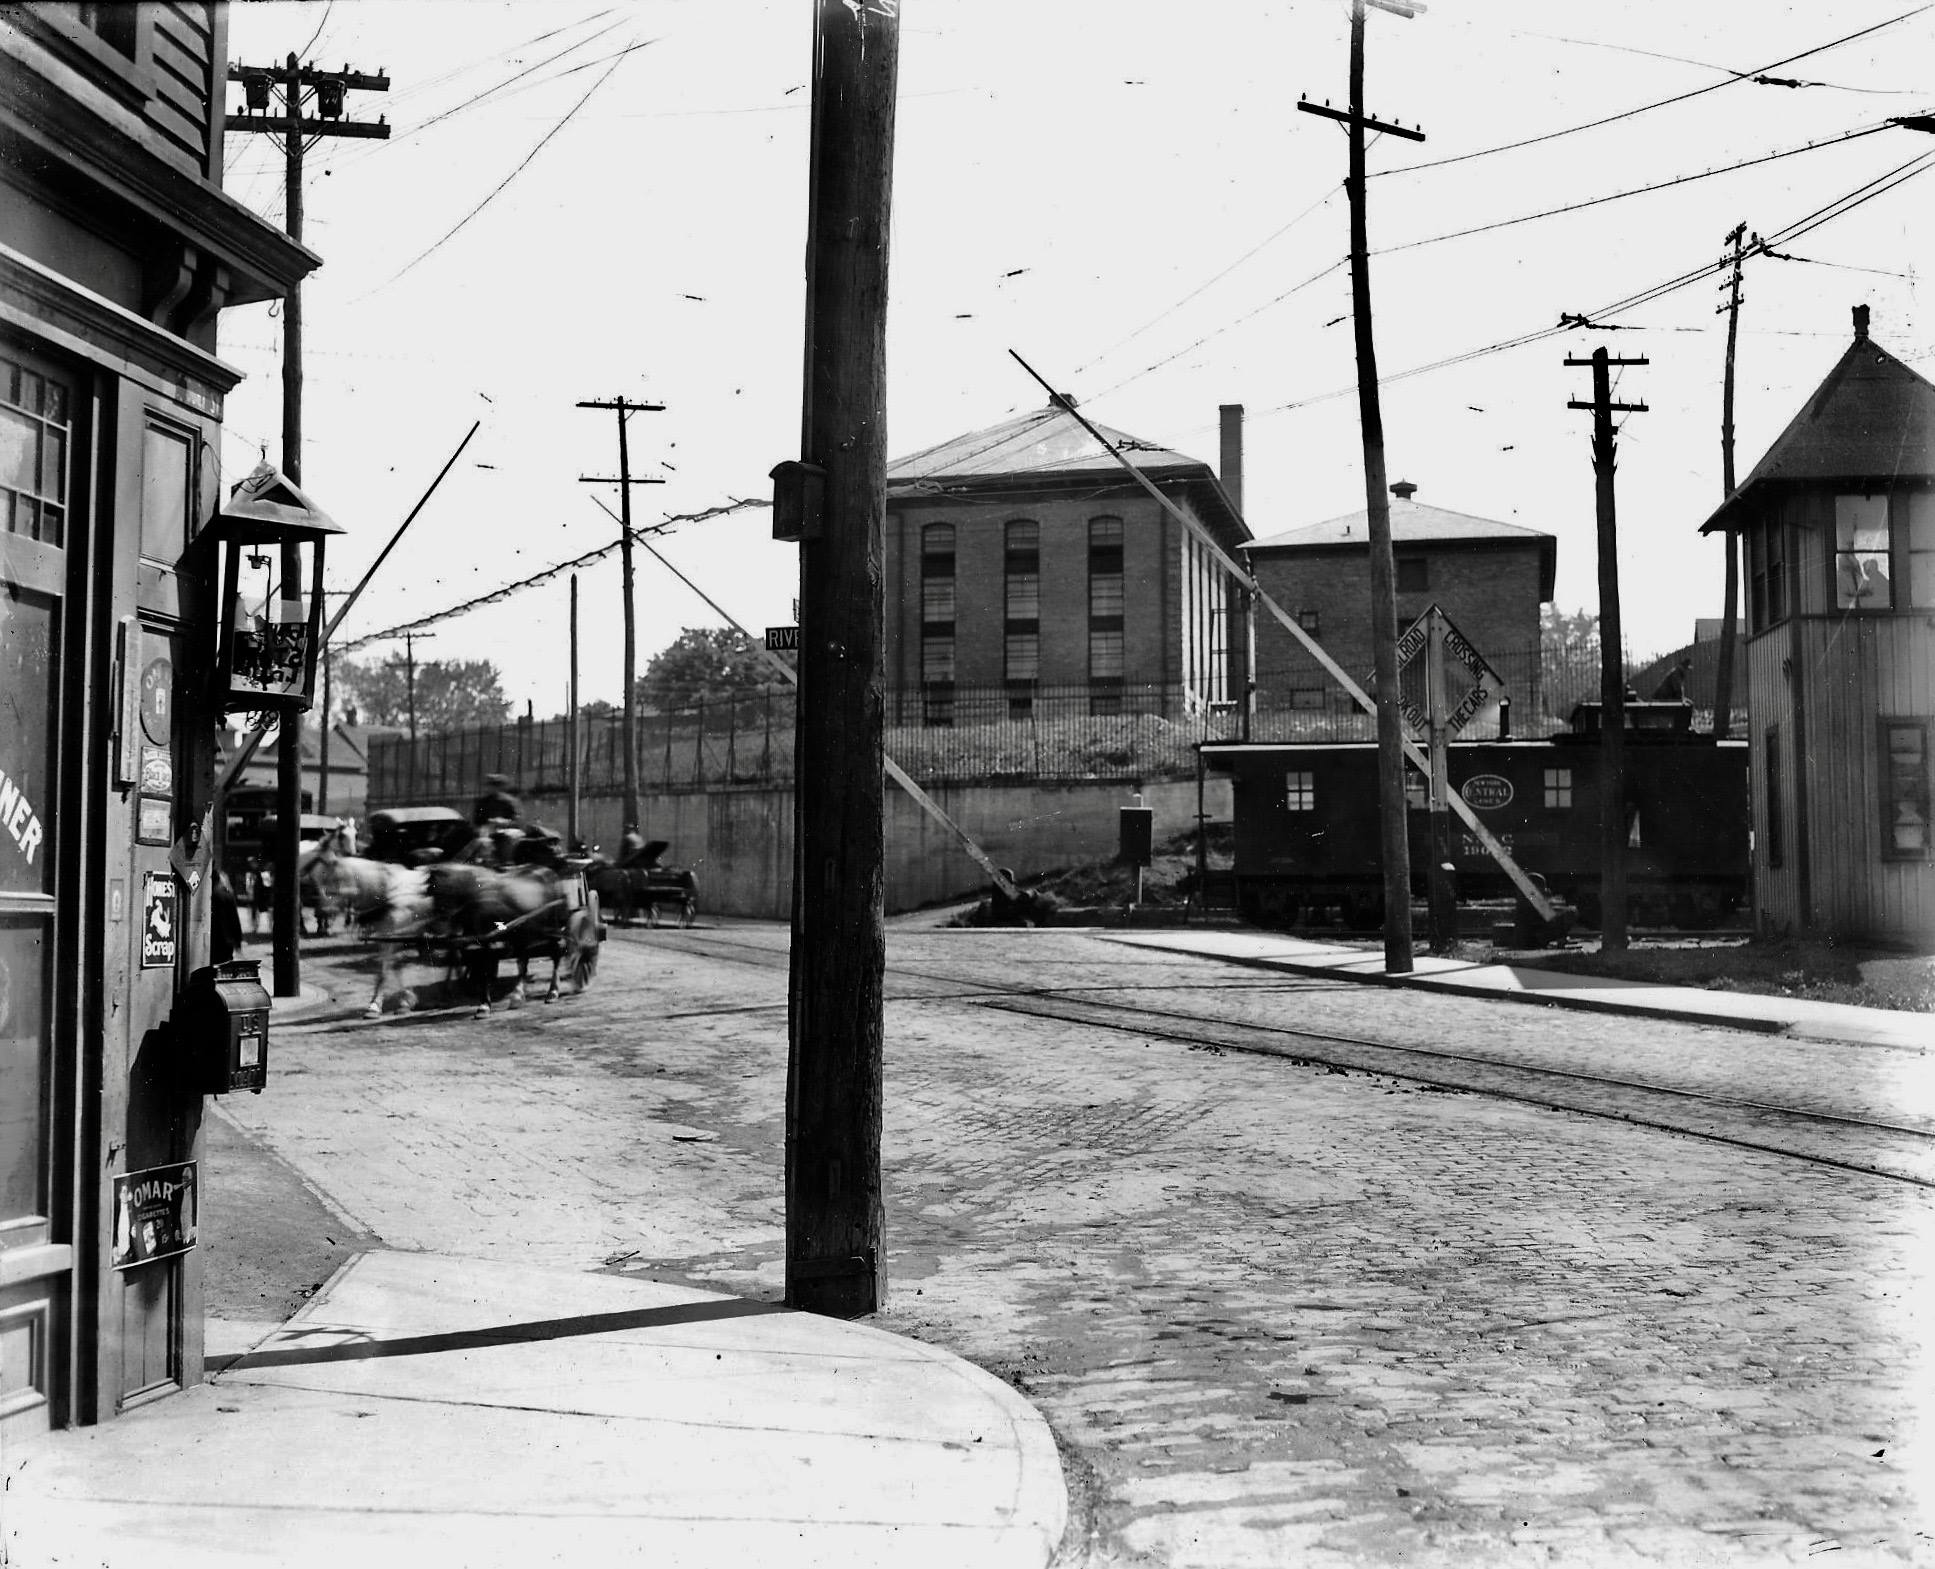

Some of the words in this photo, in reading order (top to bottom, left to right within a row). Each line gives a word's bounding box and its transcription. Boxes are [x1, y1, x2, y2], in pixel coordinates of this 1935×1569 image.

[1444, 631, 1486, 680] CROSSING
[1407, 708, 1429, 732] OUT
[1447, 706, 1470, 732] THE
[1462, 687, 1489, 716] CARS
[0, 770, 42, 865] NER
[145, 933, 174, 962] Scrap
[133, 1180, 174, 1208] OMAR
